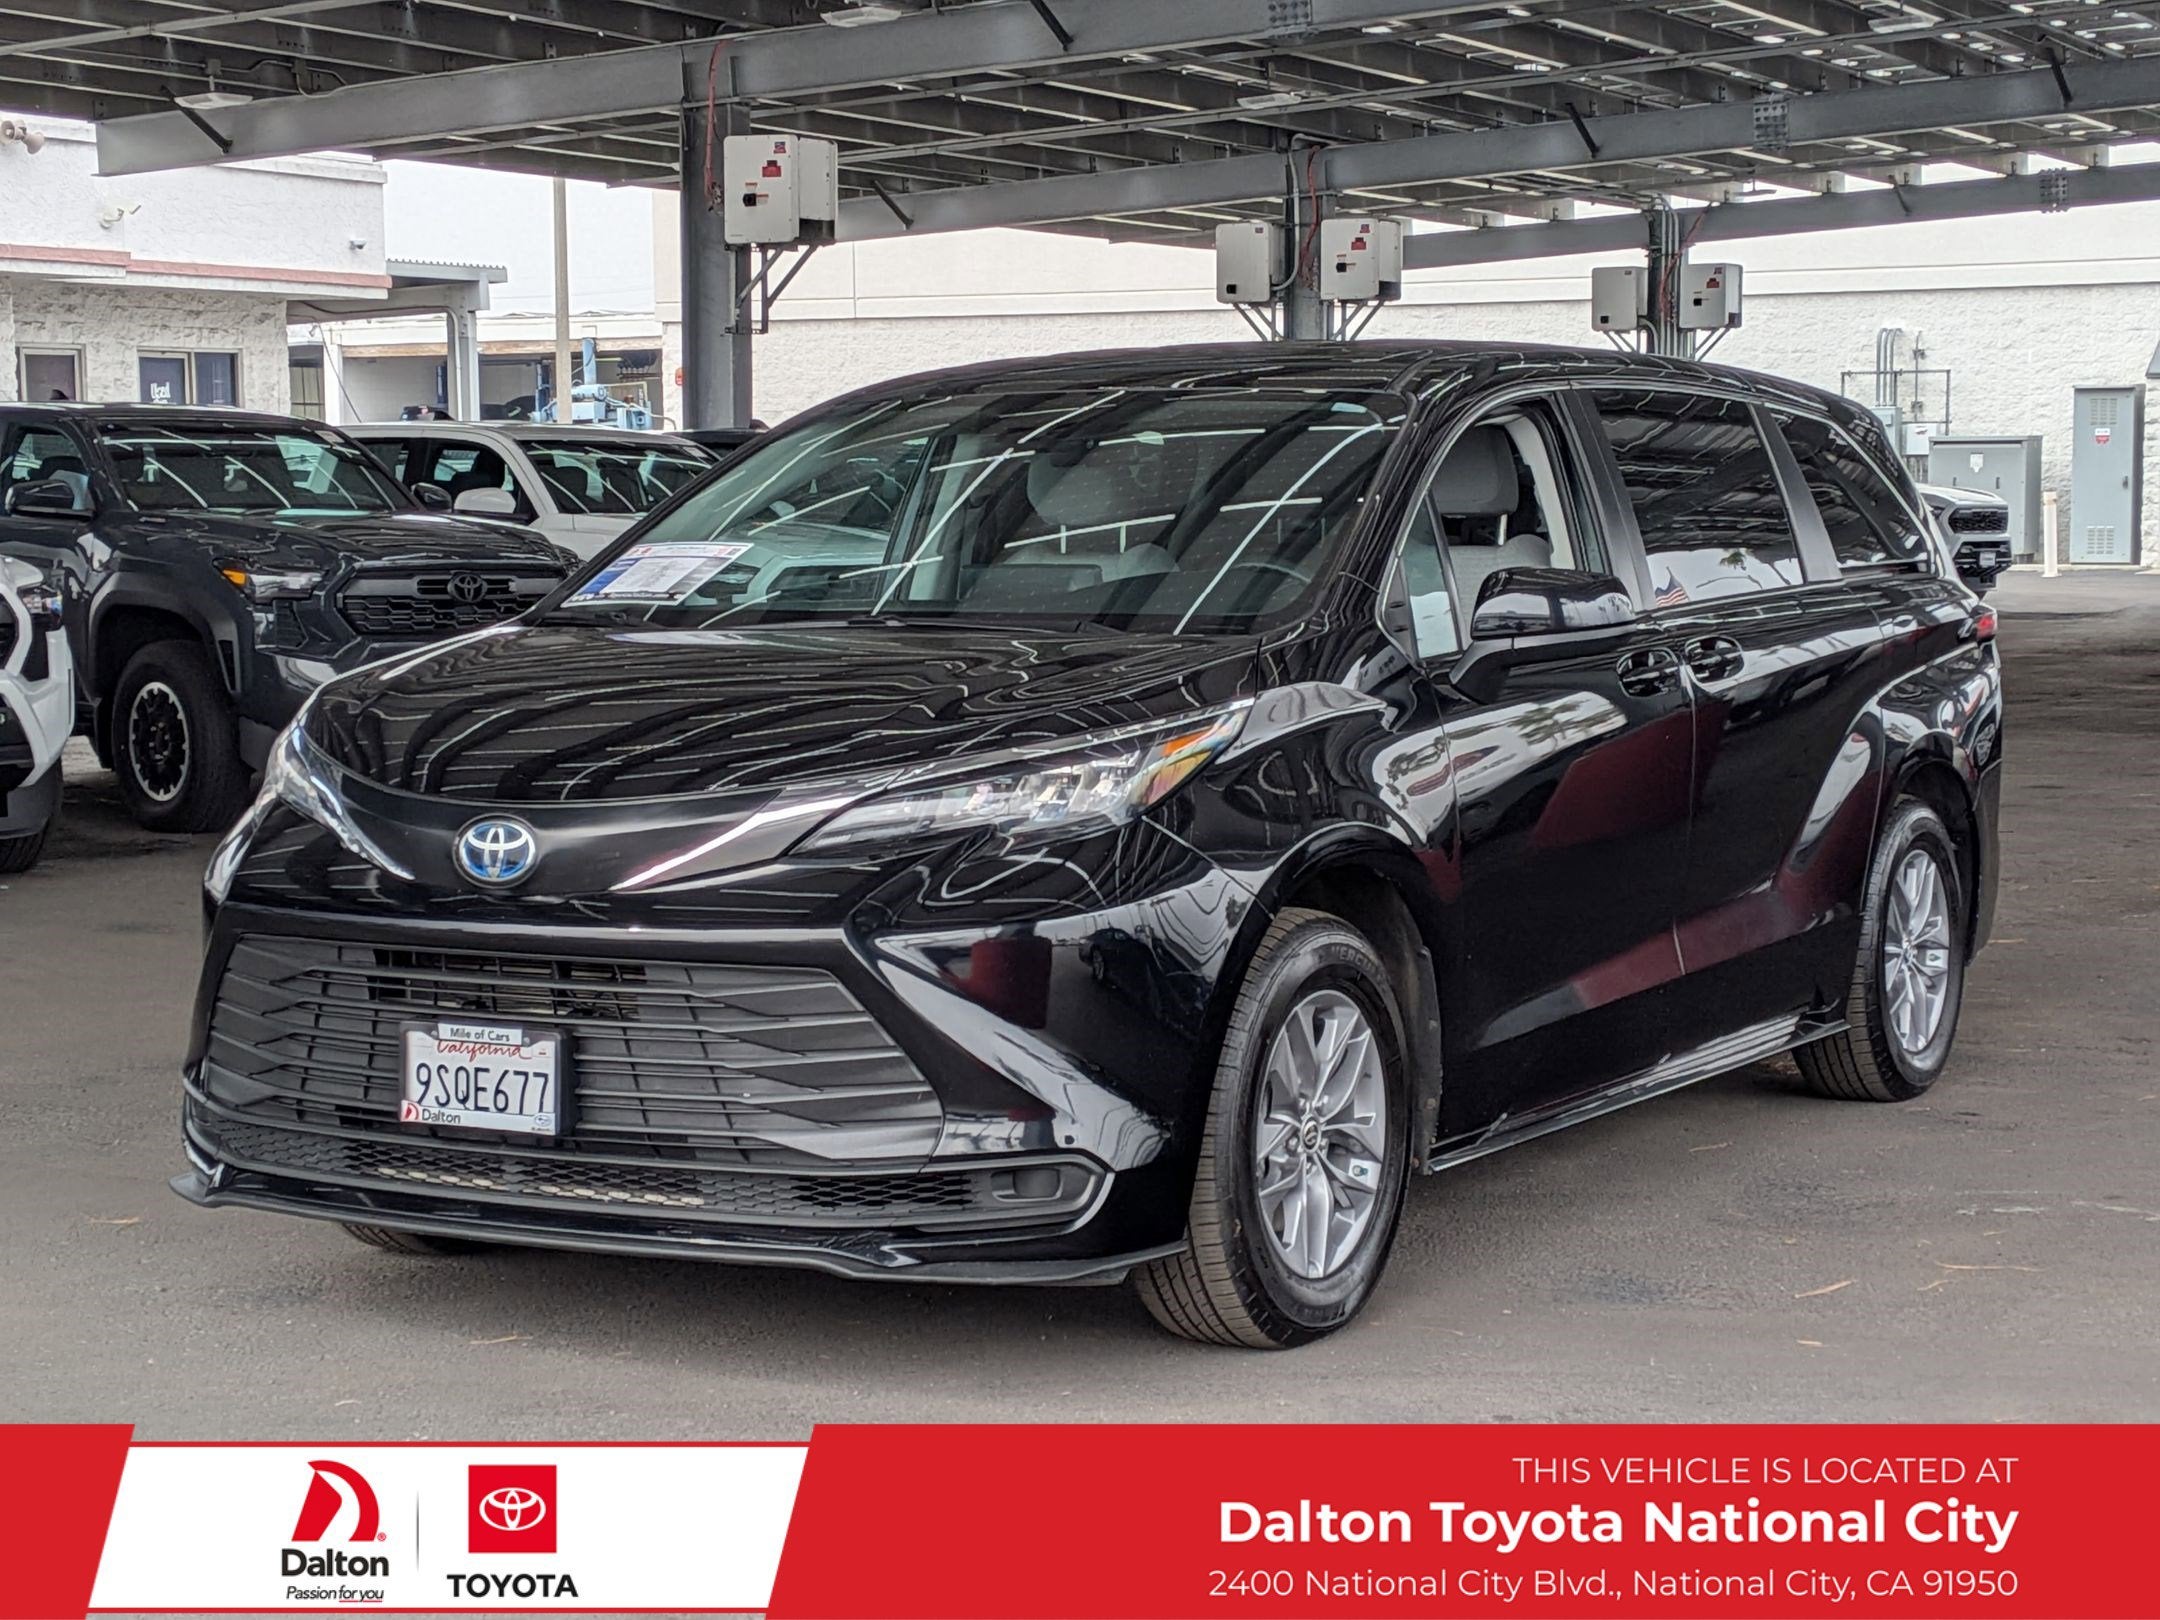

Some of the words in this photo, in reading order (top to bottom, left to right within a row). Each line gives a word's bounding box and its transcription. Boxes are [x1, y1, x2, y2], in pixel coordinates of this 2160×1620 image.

[450, 1027, 471, 1039] Mile
[474, 1030, 485, 1040] of
[487, 1030, 510, 1042] Cars
[437, 1039, 532, 1062] California
[416, 1062, 549, 1116] 9SQE677
[421, 1108, 461, 1124] Dalton
